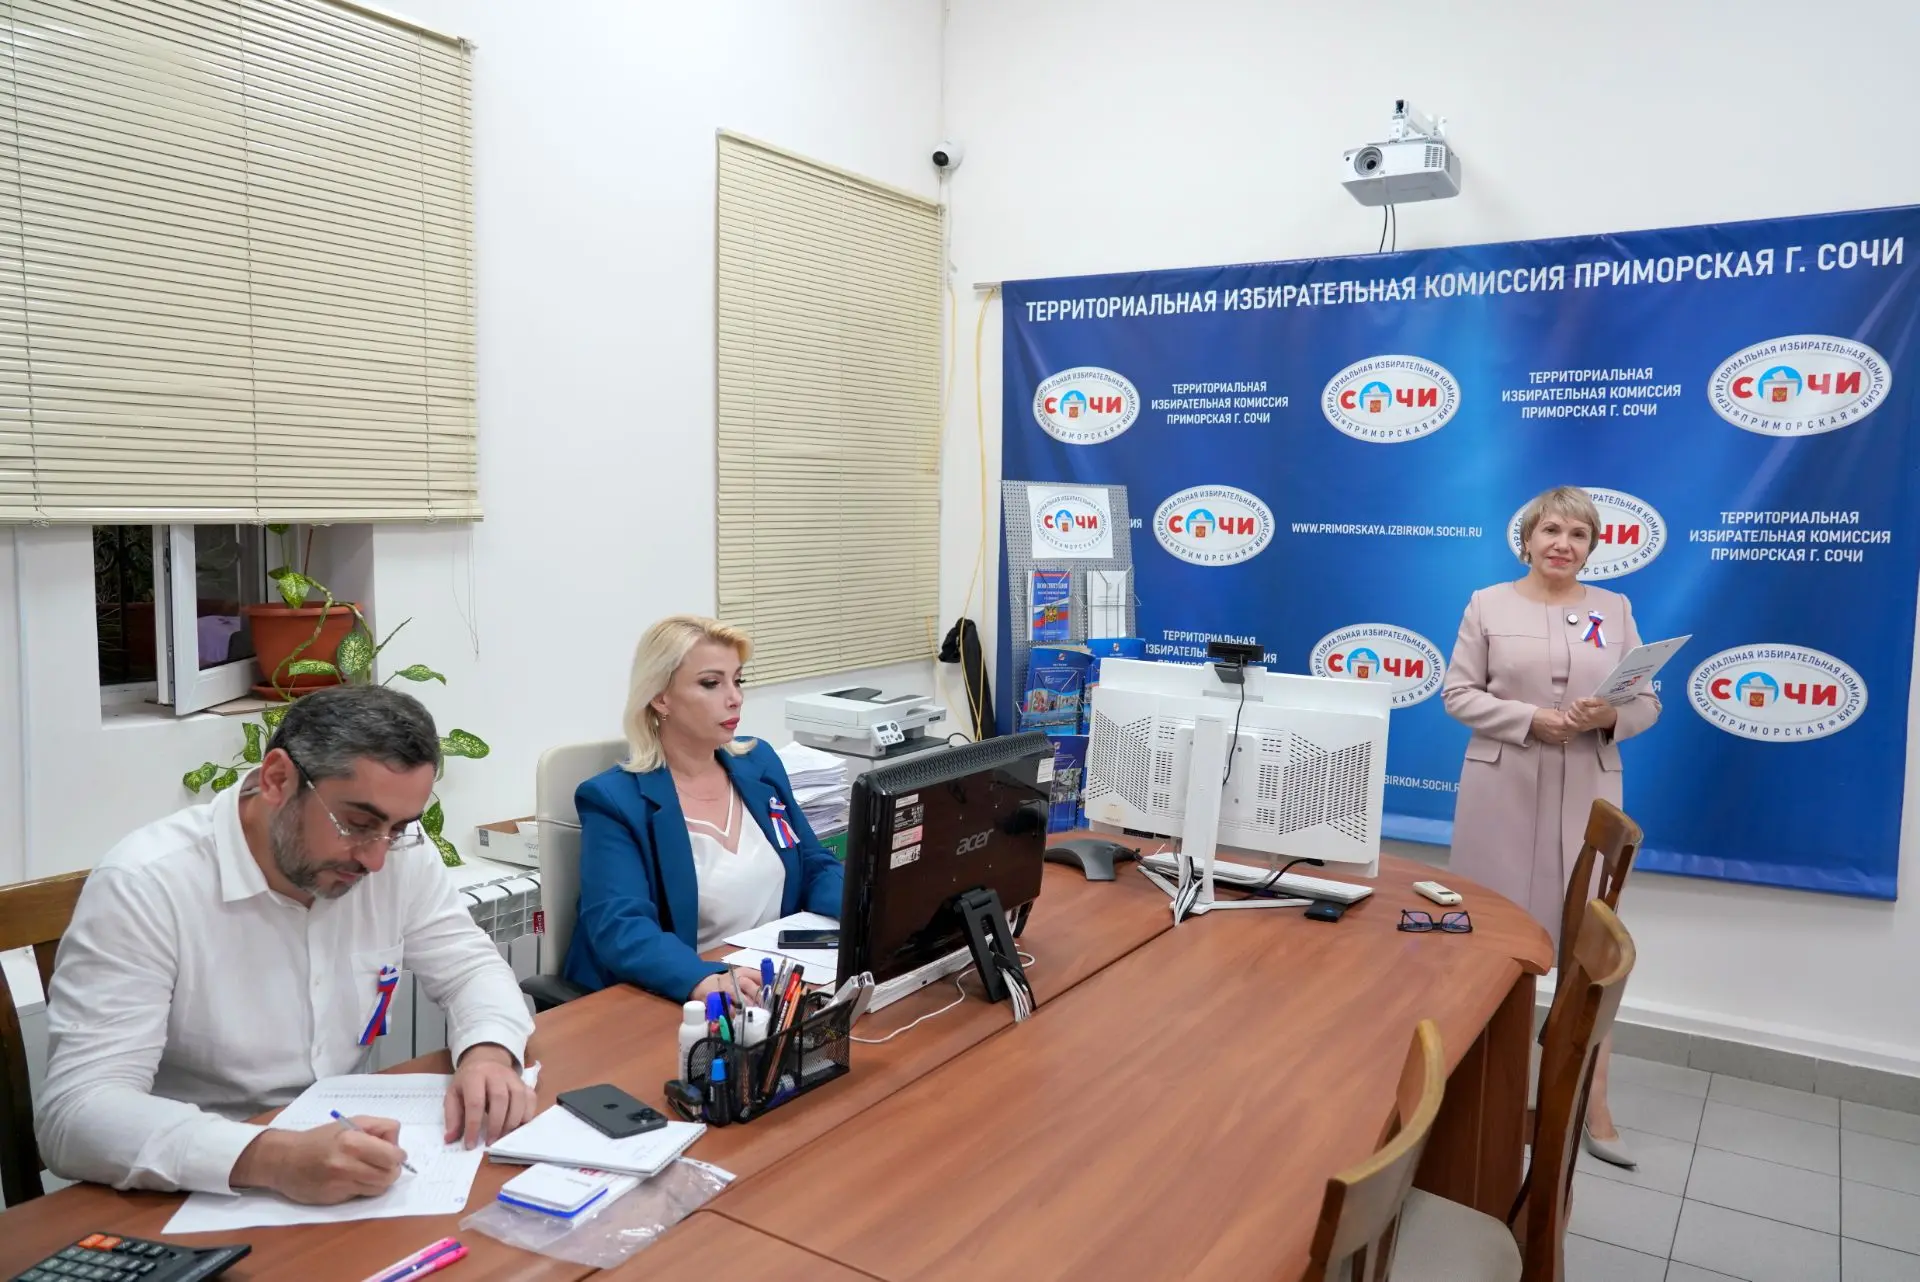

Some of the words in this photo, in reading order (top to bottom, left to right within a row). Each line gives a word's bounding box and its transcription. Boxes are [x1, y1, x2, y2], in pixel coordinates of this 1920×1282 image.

[1026, 290, 1217, 323] ТЕРРИТОРИАЛЬНАЯ
[1224, 275, 1417, 311] ИЗБИРАТЕЛЬНАЯ
[1425, 265, 1565, 299] КОМИССИЯ
[1574, 248, 1774, 289] ПРИМОРСКАЯ
[1785, 246, 1807, 274] Г.
[1816, 236, 1905, 271] СОЧИ
[1529, 367, 1653, 385] ТЕРРИТОРИАЛЬНАЯ
[1171, 381, 1267, 394] ТЕРРИТОРИАЛЬНАЯ
[1502, 385, 1607, 402] ИЗБИРАТЕЛЬНАЯ
[1609, 383, 1682, 400] КОМИССИЯ
[1151, 398, 1231, 410] ИЗБИРАТЕЛЬНАЯ
[1233, 396, 1289, 409] КОМИССИЯ
[1166, 413, 1232, 425] ПРИМОРСКАЯ
[1234, 413, 1242, 424] Г.
[1243, 412, 1271, 424] СОЧИ
[1521, 404, 1607, 419] ПРИМОРСКАЯ
[1610, 404, 1620, 417] Г.
[1622, 403, 1658, 417] СОЧИ
[1720, 511, 1860, 526] ТЕРРИТОРИАЛЬНАЯ
[1291, 522, 1482, 537] WWW.PRIMORSKAYA.IZBIRKOM.SOCHI.RU
[1689, 529, 1807, 544] ИЗБИРАТЕЛЬНАЯ
[1810, 529, 1891, 545] КОМИССИЯ
[1711, 548, 1807, 562] ПРИМОРСКАЯ
[1810, 548, 1821, 562] Г.
[1824, 549, 1864, 563] СОЧИ
[956, 828, 995, 855] acer
